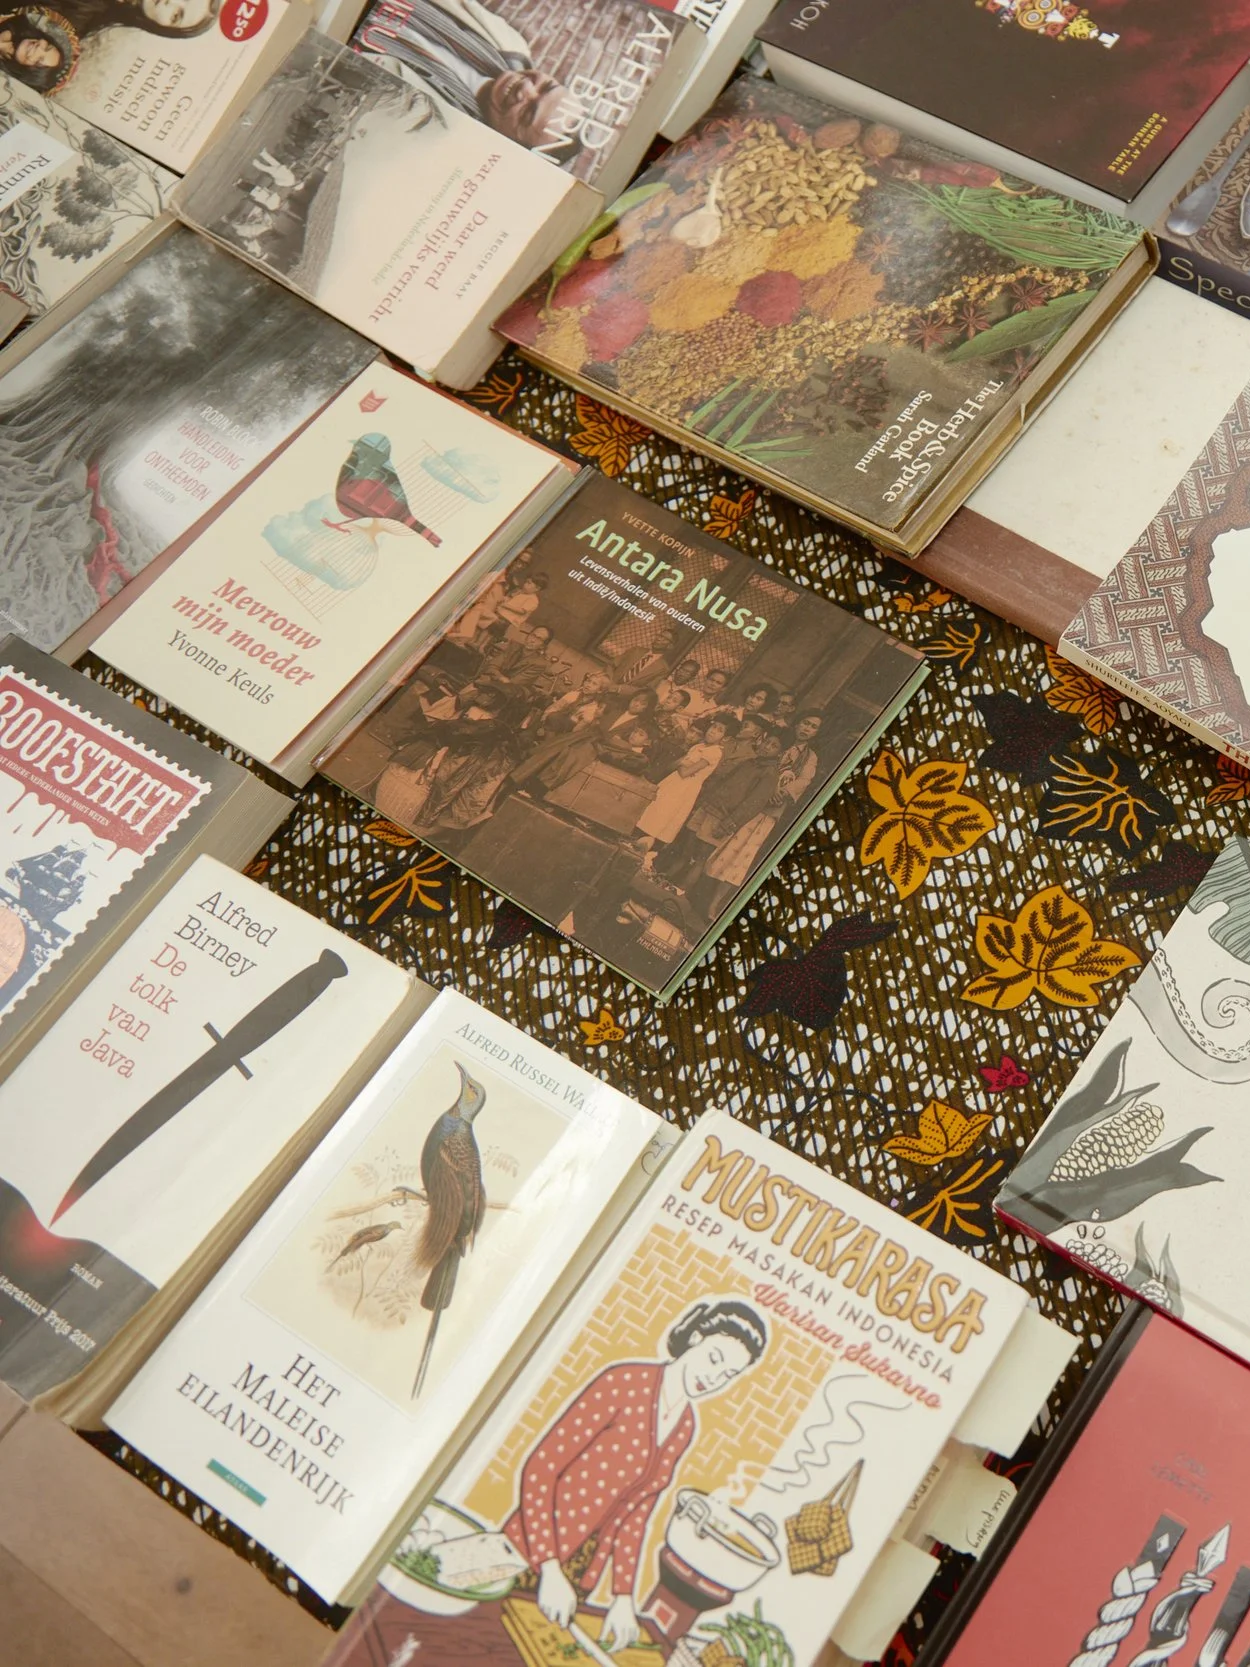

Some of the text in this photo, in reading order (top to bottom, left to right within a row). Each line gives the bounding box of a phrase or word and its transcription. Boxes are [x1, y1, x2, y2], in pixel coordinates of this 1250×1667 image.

[119, 57, 170, 125] Indisch
[136, 61, 187, 133] gewoon
[579, 11, 672, 151] ALFRED
[153, 93, 194, 144] Geen
[1116, 161, 1132, 175] THE
[366, 150, 504, 326] wat gruwelijks verricht
[423, 208, 489, 290] Daar werd
[933, 396, 984, 443] Herb
[975, 379, 1003, 403] The
[177, 421, 245, 472] HANDLEIDING
[178, 447, 211, 474] VOOR
[854, 390, 932, 473] Sarah Garland
[887, 417, 940, 461] Book
[144, 450, 211, 501] ONTHEEMDEN
[881, 456, 931, 503] Spice
[621, 510, 697, 559] YVETTE KOPIJN
[568, 568, 586, 586] uit
[575, 517, 771, 643] Antara Nusa
[579, 554, 706, 634] Levensverhalen van ouderen
[172, 593, 315, 687] mijn moeder
[211, 577, 322, 651] Mevrouw
[168, 629, 275, 706] Yvonne Keuls
[174, 915, 258, 978] Birney
[197, 890, 279, 949] Alfred
[150, 942, 187, 978] De
[107, 1003, 152, 1042] van
[128, 973, 179, 1014] tolk
[79, 1028, 136, 1079] Java
[455, 1022, 511, 1063] ALFRED
[510, 1053, 561, 1096] RUSSEL
[680, 1134, 988, 1357] MUSTIKARASA
[70, 1263, 104, 1292] ROMAN
[661, 1193, 954, 1385] RESEP MASAKAN INDONESIA
[751, 1283, 943, 1411] Warisan Sukarno
[232, 1362, 346, 1460] MALEISE
[281, 1353, 341, 1409] HET
[175, 1372, 357, 1515] EILANDENRIJK
